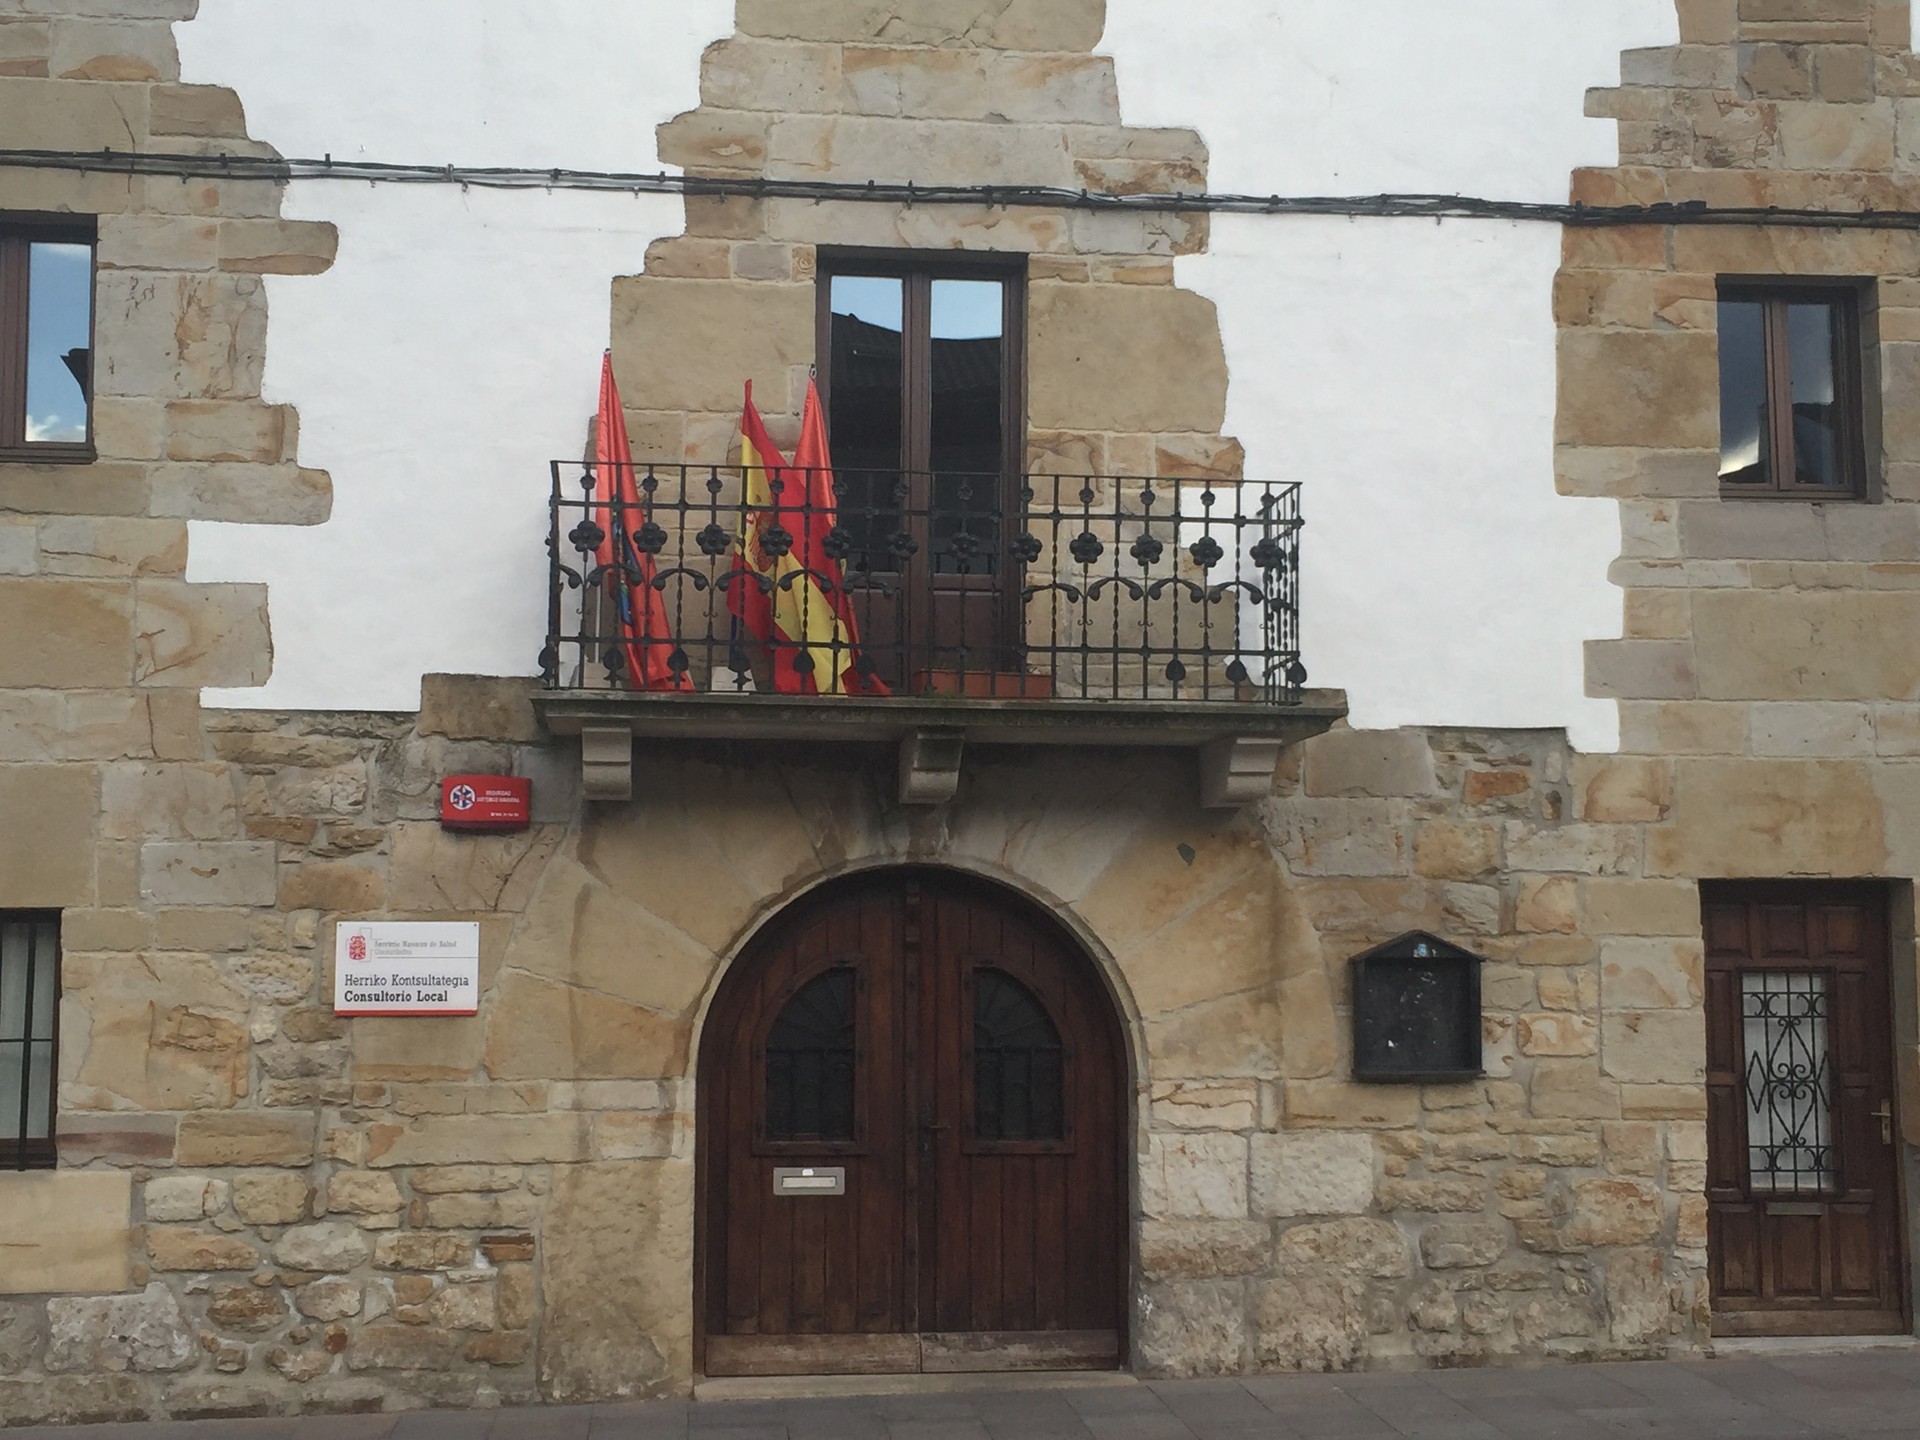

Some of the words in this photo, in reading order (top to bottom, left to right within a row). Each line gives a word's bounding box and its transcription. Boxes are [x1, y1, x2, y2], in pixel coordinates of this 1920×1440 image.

[344, 974, 387, 986] Herriko
[391, 974, 469, 988] Kontsultategia
[344, 990, 412, 1002] Consultorio
[416, 990, 448, 1002] Local
